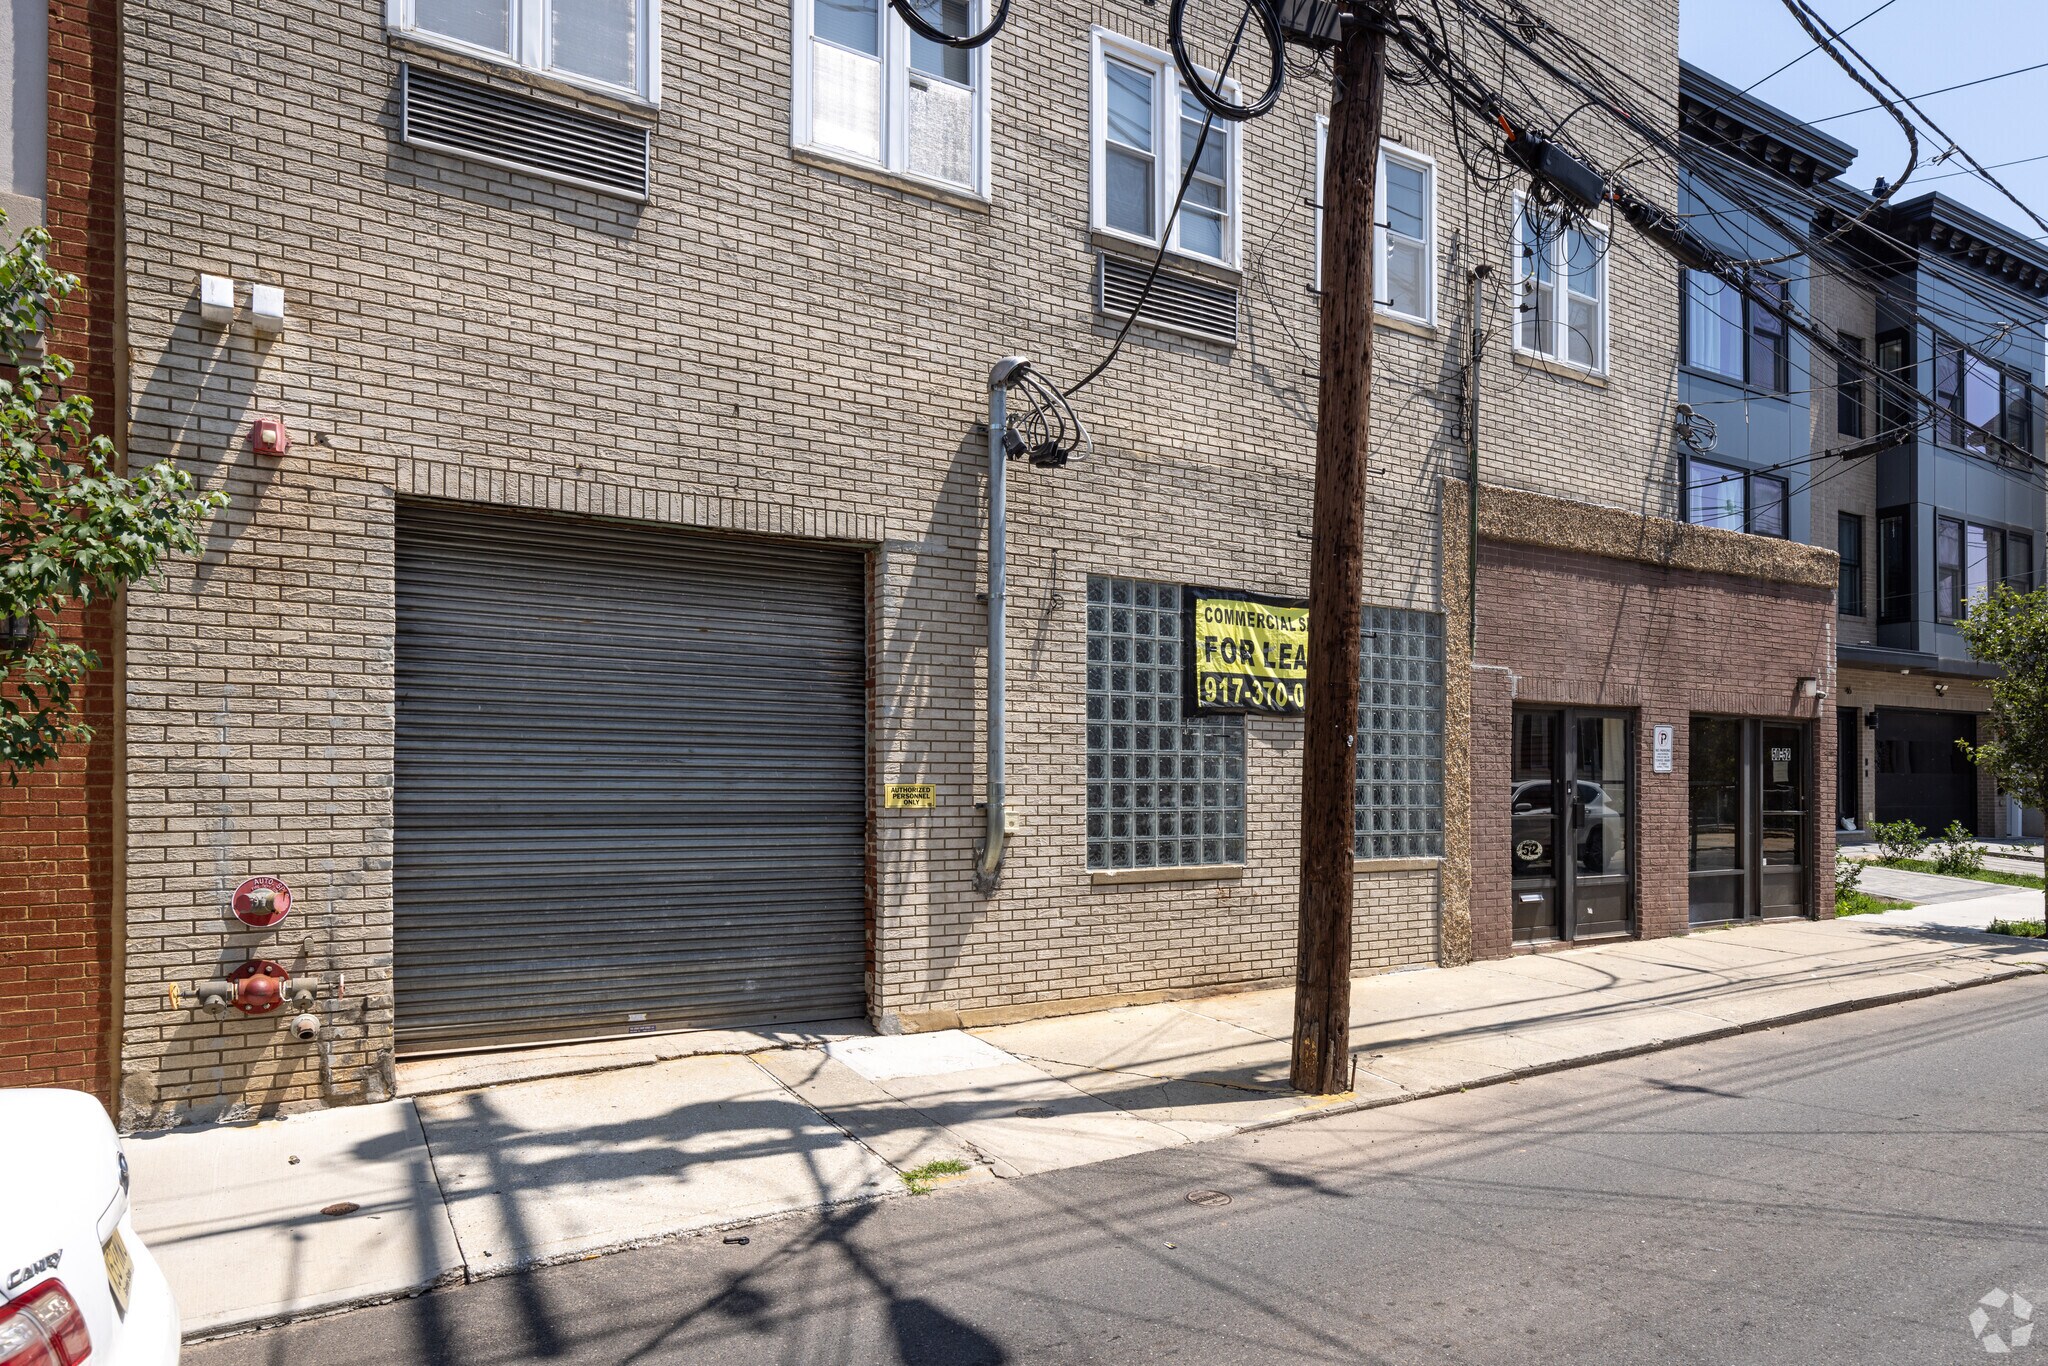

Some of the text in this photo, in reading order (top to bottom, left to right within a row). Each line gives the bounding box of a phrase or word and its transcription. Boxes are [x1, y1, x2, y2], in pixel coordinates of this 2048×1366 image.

[1204, 606, 1296, 632] COMMERCIAL
[1204, 636, 1307, 670] FOR LEA
[1204, 677, 1304, 708] 917-370-0
[1521, 843, 1539, 856] 52
[6, 1248, 63, 1291] CAMRY
